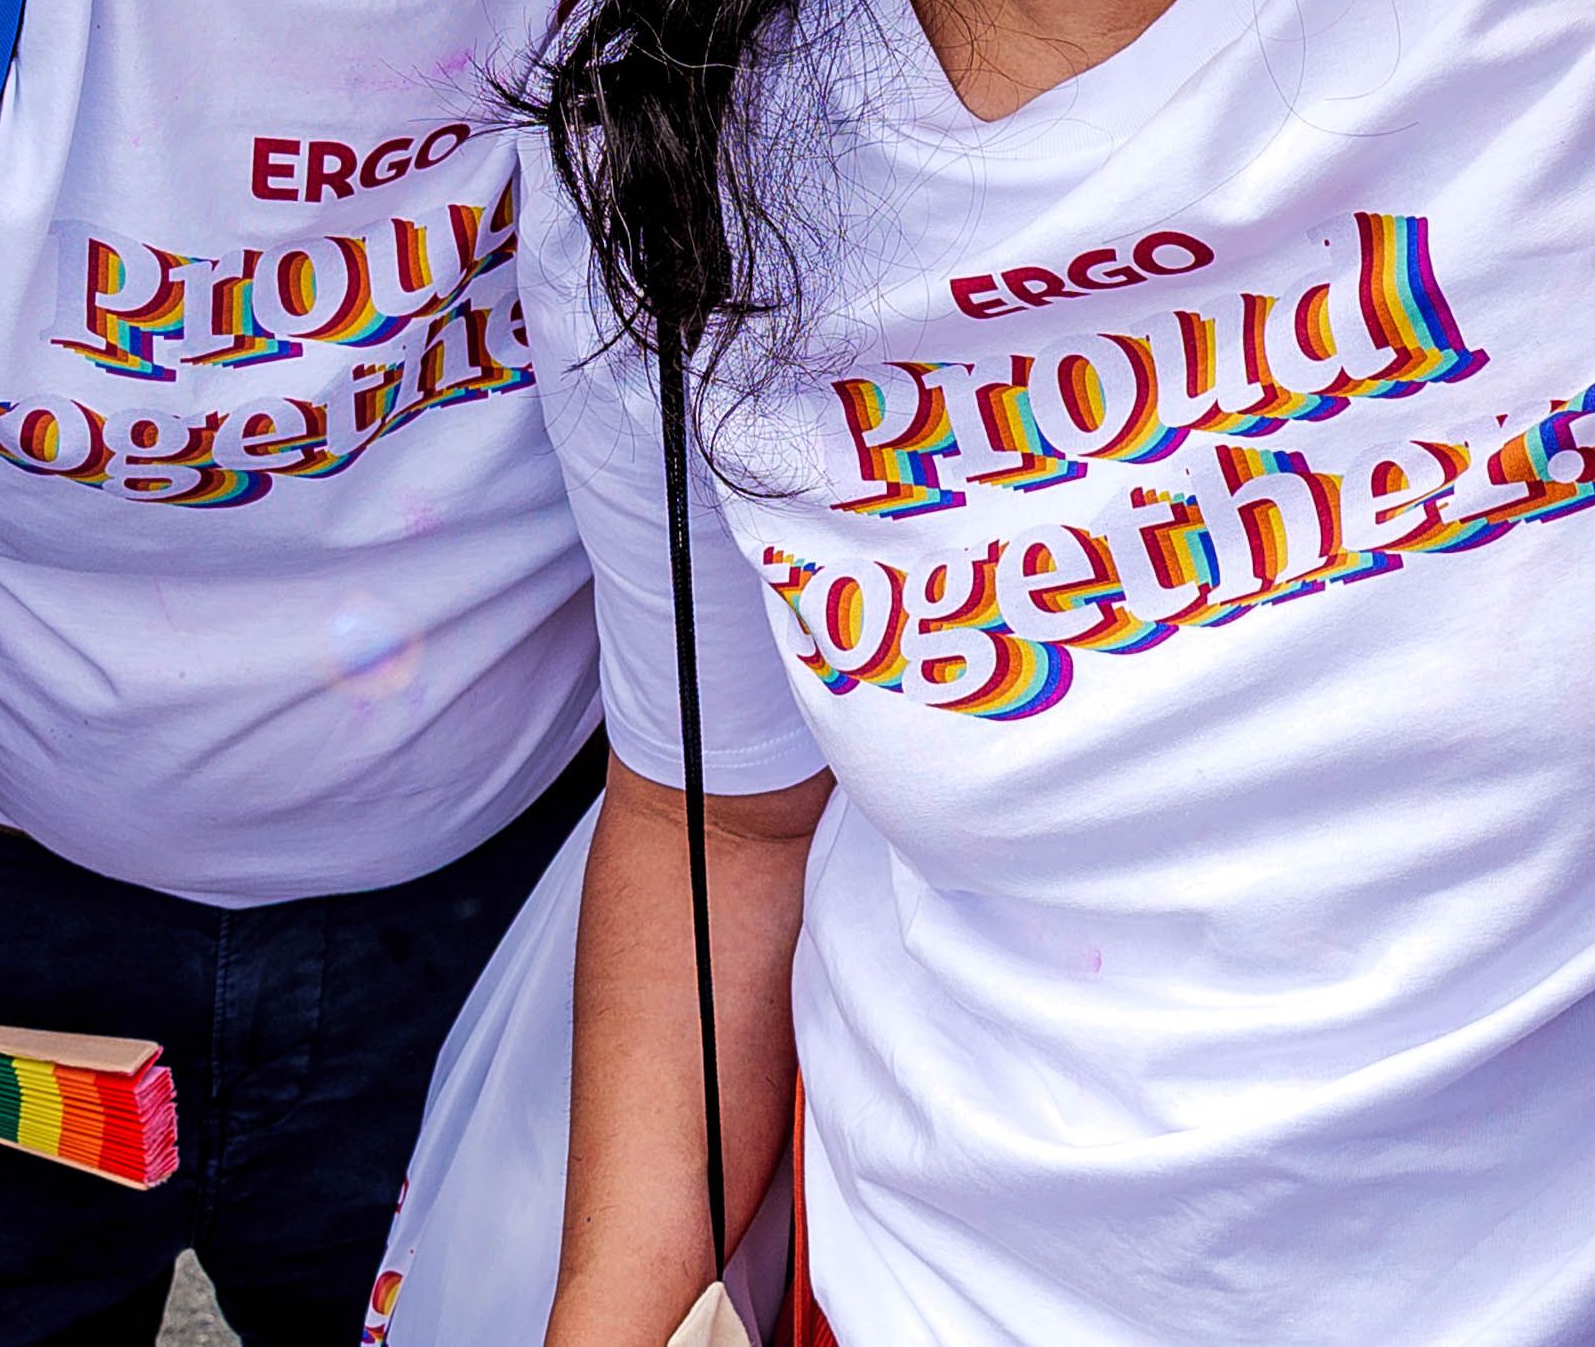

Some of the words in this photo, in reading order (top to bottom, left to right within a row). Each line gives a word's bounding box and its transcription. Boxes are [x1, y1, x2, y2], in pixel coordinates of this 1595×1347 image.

[251, 123, 472, 203] ERGO
[949, 230, 1215, 320] ERGO
[824, 210, 1491, 521] Proud
